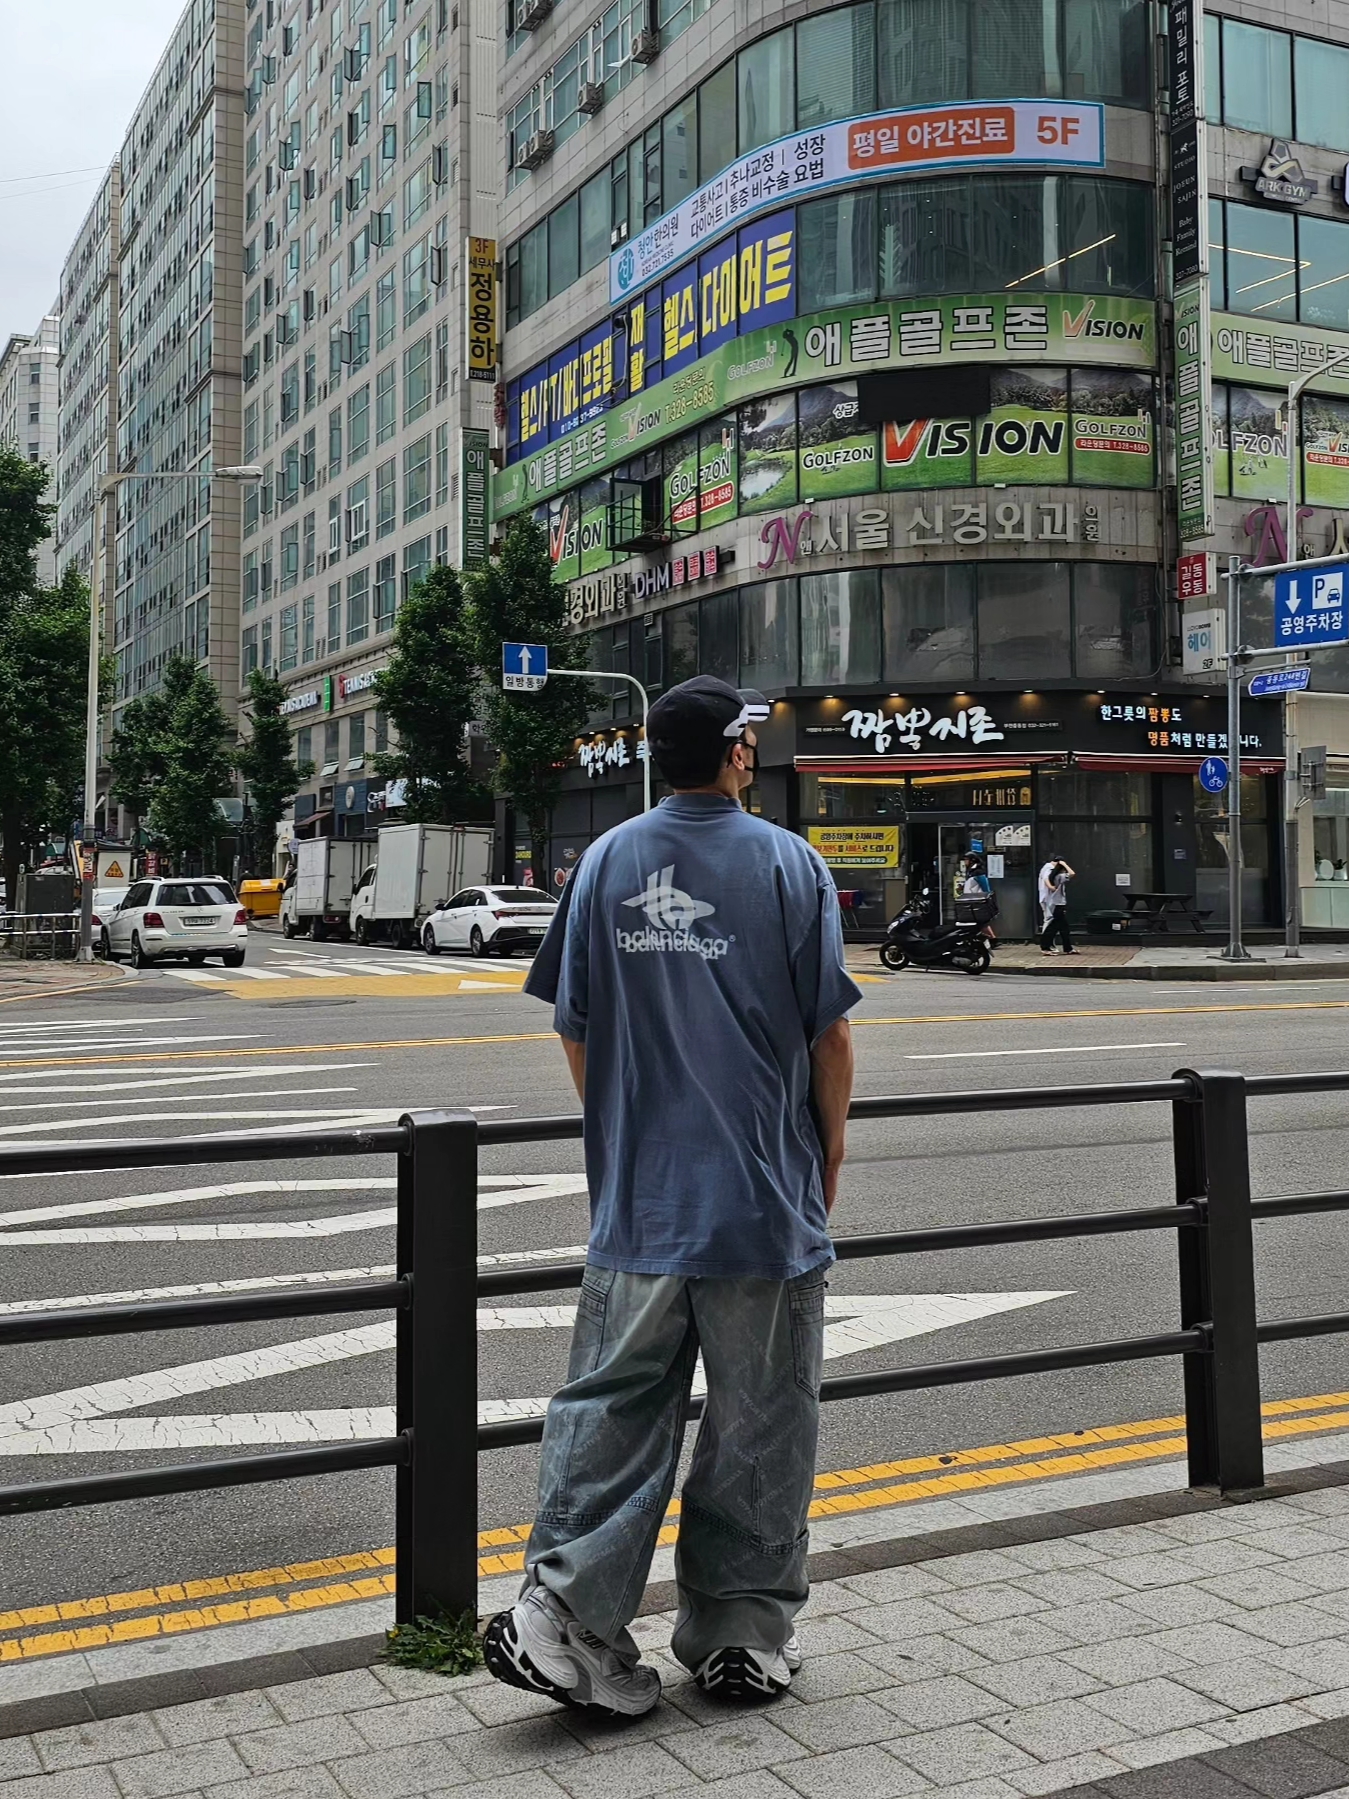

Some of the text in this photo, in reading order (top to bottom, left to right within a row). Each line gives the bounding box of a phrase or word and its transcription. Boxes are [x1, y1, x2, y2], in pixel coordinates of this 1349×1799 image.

[1175, 5, 1187, 64] 패밀리
[1175, 69, 1190, 105] 포토
[853, 117, 1008, 158] 평일 야간진료
[1036, 115, 1081, 146] 5F
[691, 133, 826, 219] 교통사고 추나교정 성장
[1258, 181, 1281, 194] ARK
[690, 157, 824, 239] 다이어트 통증 비수술 요법
[475, 238, 489, 254] 3F
[637, 212, 679, 261] 청안한의원
[468, 256, 496, 271] 세무사
[664, 284, 694, 361] 헬스
[701, 231, 793, 338] 다이어트
[1176, 303, 1201, 322] VISION
[470, 272, 495, 367] 정용하
[804, 304, 1049, 368] 애플골프존
[1062, 300, 1146, 341] VISION
[1217, 328, 1349, 379] 애플골프존
[628, 401, 662, 443] VISION
[664, 382, 714, 425] T.328-8585
[1176, 321, 1202, 512] 애플골프존
[884, 418, 1065, 468] VISION
[1074, 418, 1147, 440] GOLFZON
[1211, 429, 1288, 459] LFZON
[528, 421, 607, 493] 애플골프존
[669, 456, 731, 499] GOLFZON
[801, 446, 875, 470] GOLFZON
[466, 449, 485, 561] 애플골프존
[550, 504, 604, 566] VISION
[815, 508, 890, 553] 서울
[906, 502, 1078, 545] 신경외과
[635, 562, 670, 601] DHM
[1181, 578, 1203, 596] 우동
[1314, 577, 1325, 600] P
[1186, 630, 1212, 653] 헤어
[1280, 610, 1343, 636] 공영주차장
[505, 675, 545, 690] 일방통행
[1202, 658, 1214, 670] 2F
[841, 706, 1005, 754] 짬뽕지존
[1100, 704, 1147, 722] 한그릇의
[1147, 730, 1263, 750] 명품처럼 만들겠니다.
